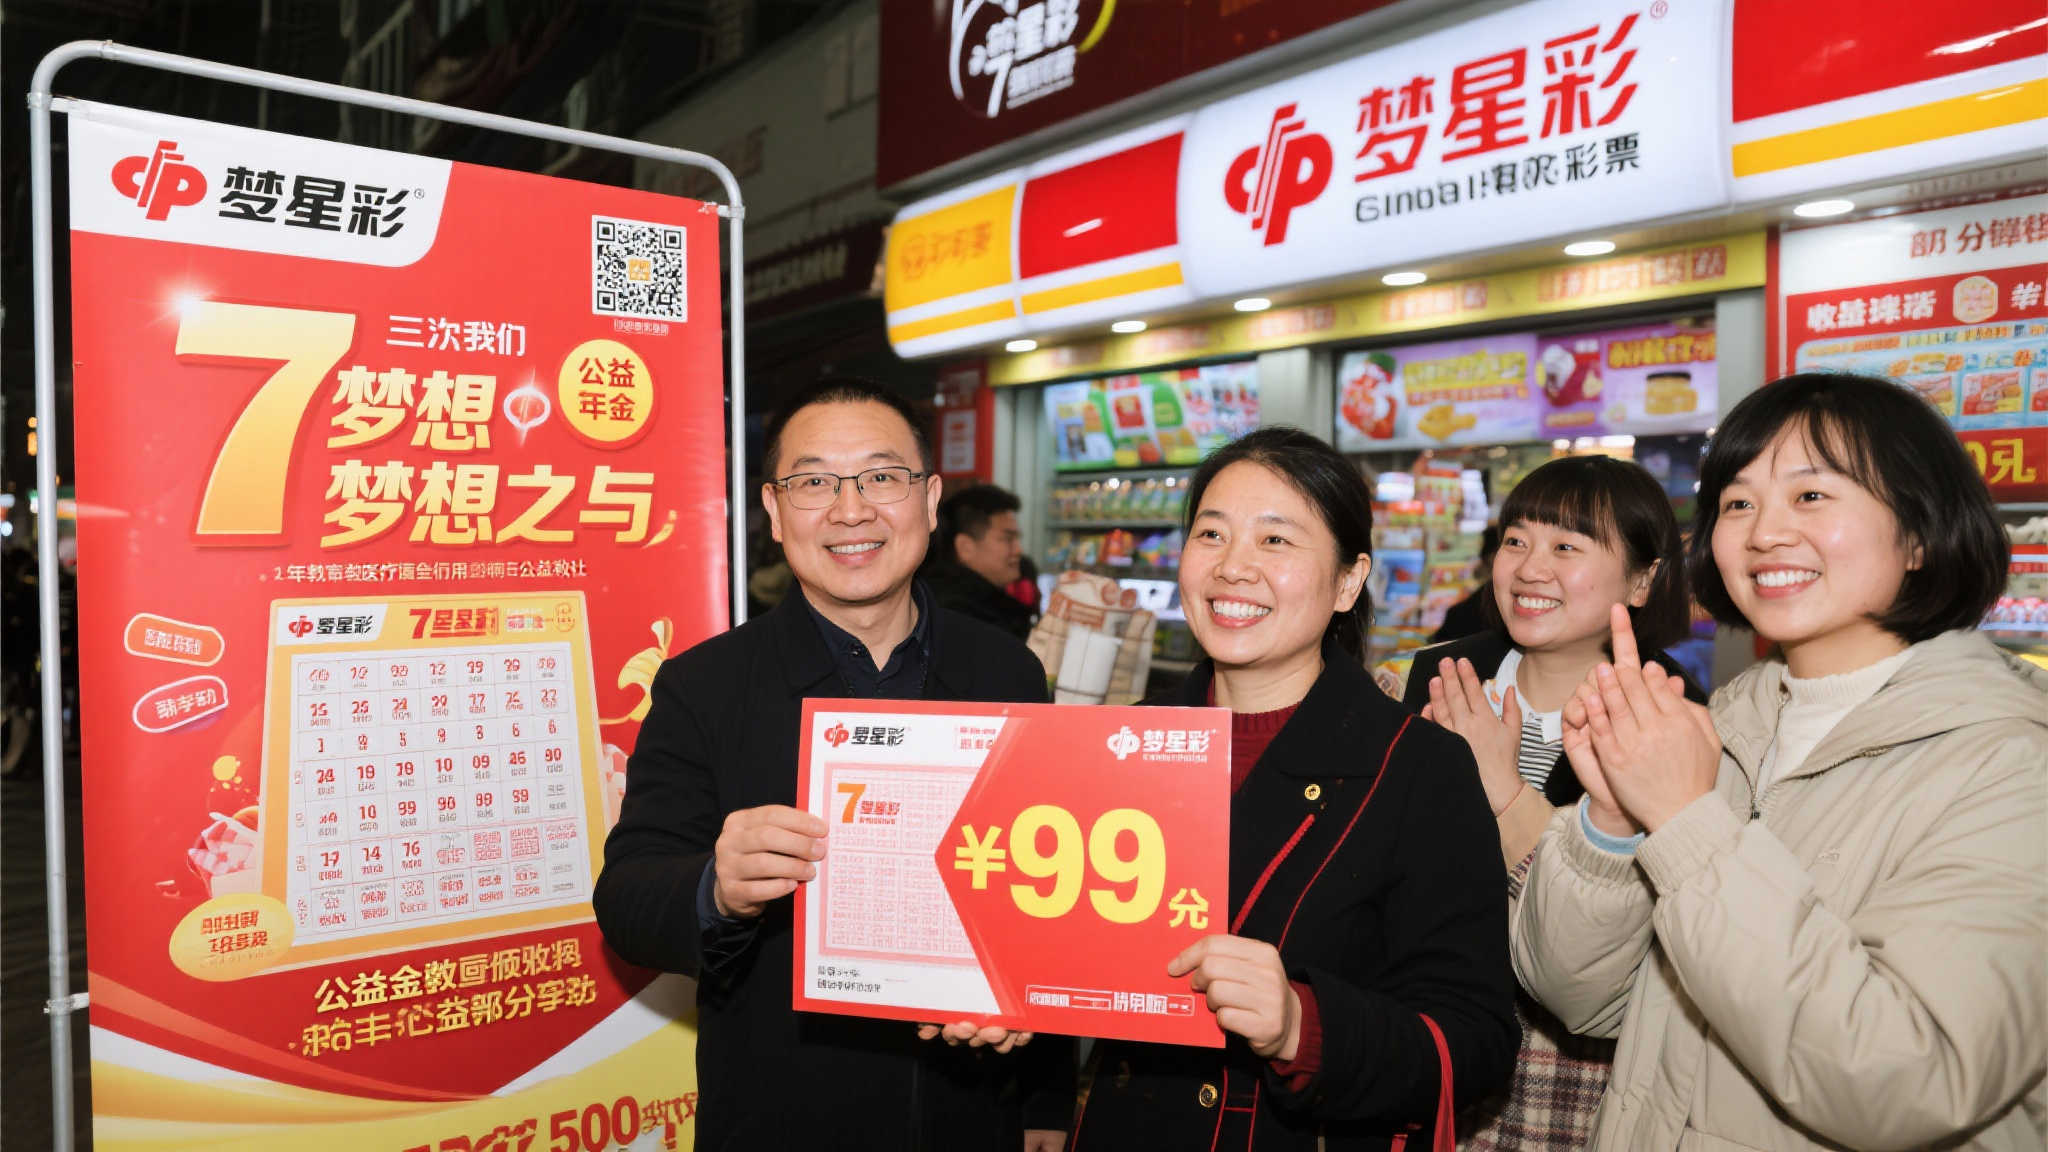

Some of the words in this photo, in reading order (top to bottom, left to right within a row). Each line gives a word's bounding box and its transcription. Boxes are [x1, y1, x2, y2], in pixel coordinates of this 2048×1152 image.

[1354, 12, 1641, 183] 梦星彩
[218, 165, 409, 239] 梦星彩
[386, 314, 526, 357] 三次我们
[578, 357, 636, 389] 公益
[175, 299, 356, 536] 7
[327, 366, 497, 451] 梦想
[578, 391, 636, 422] 年金
[436, 757, 453, 772] 10
[837, 782, 866, 824] 7
